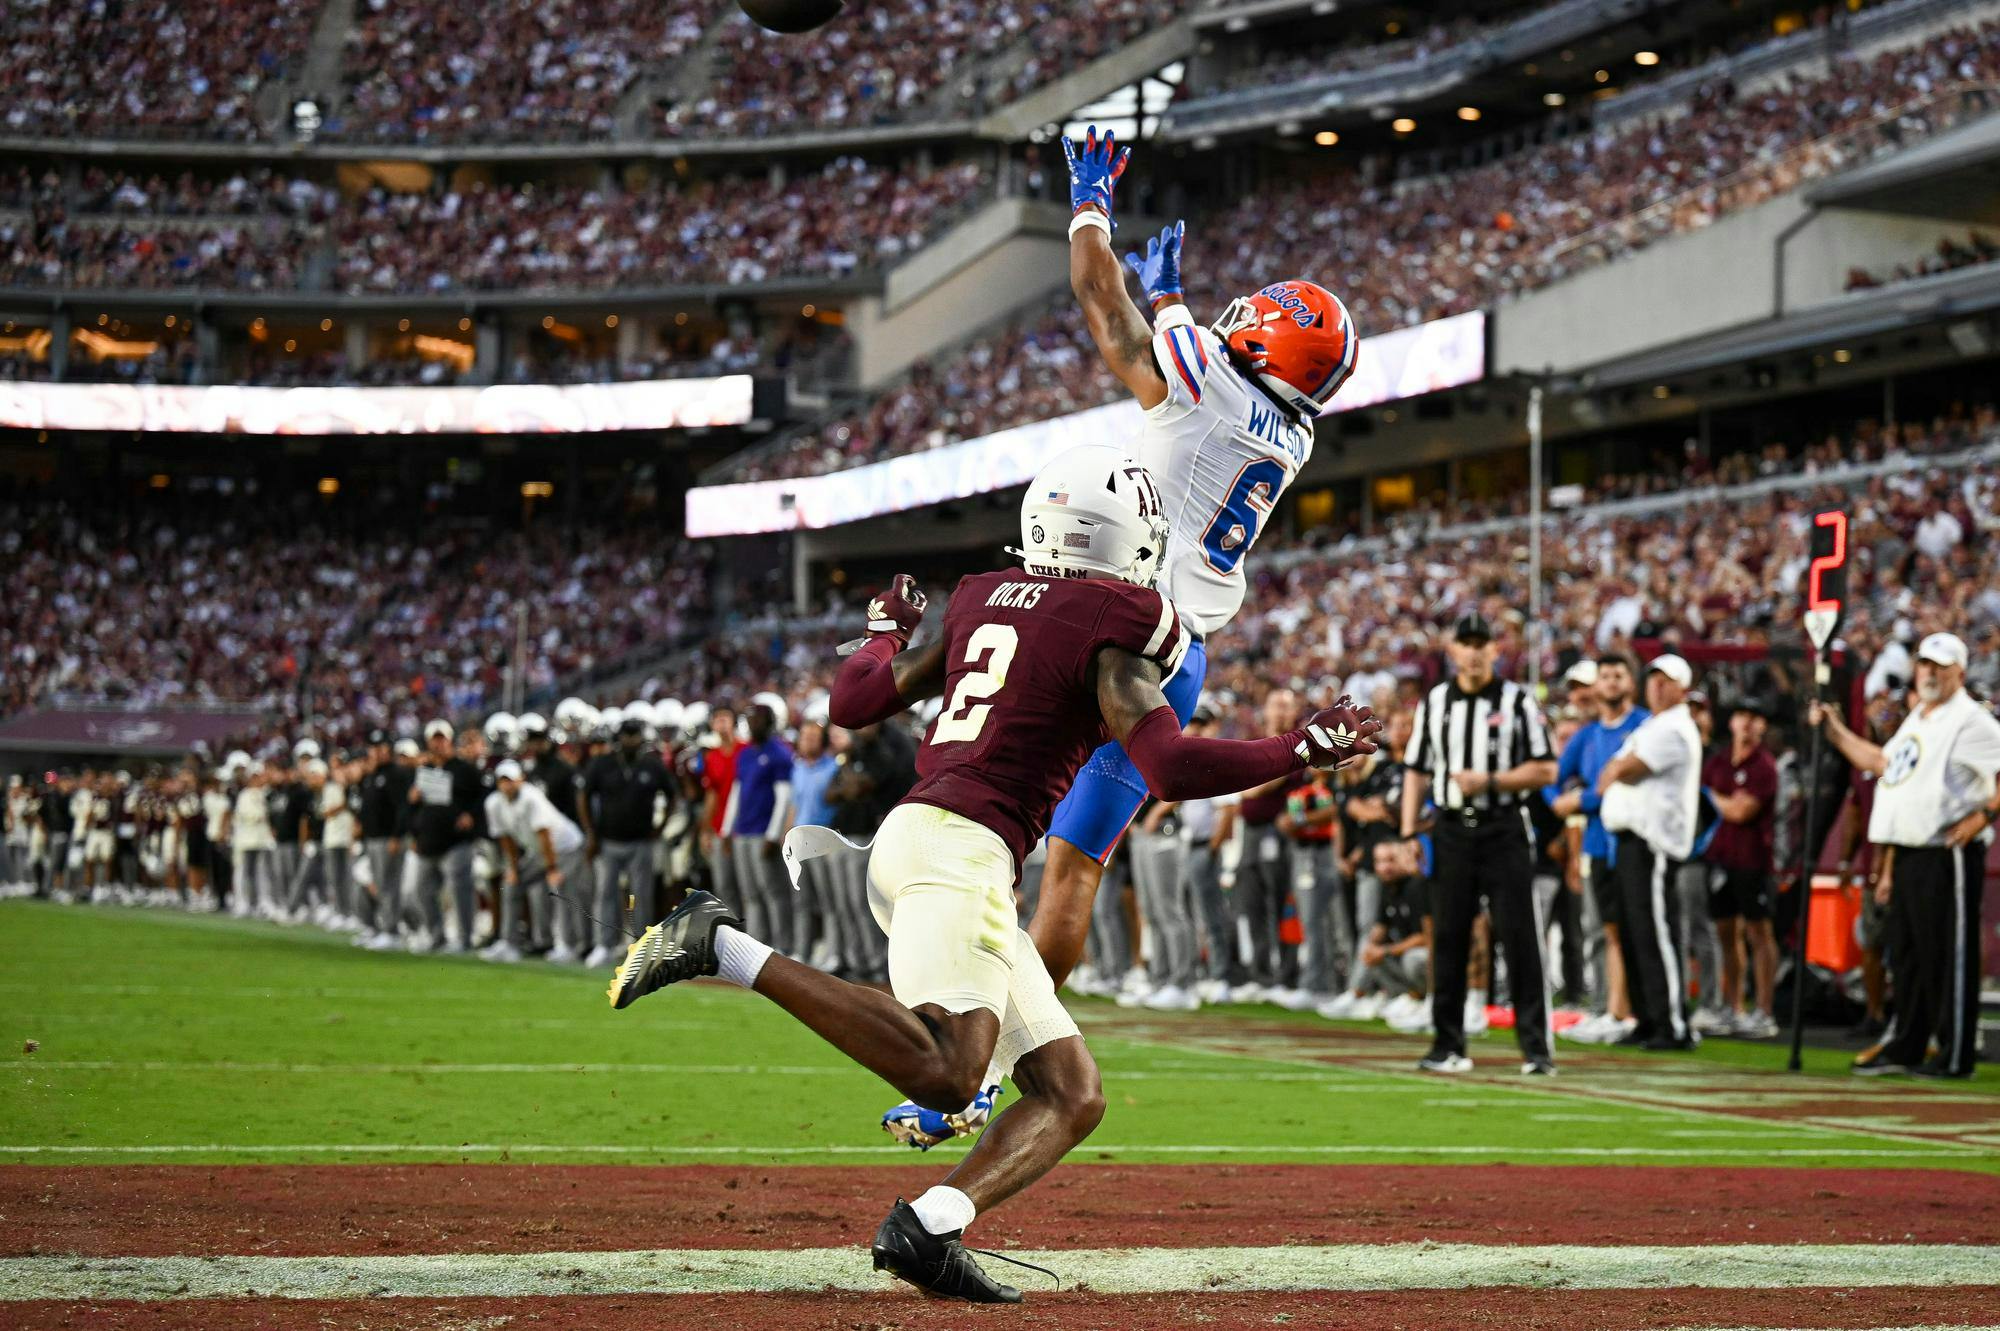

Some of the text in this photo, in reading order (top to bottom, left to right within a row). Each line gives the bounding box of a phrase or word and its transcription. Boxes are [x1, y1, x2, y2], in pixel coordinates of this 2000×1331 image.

[1200, 456, 1287, 577] 6
[1030, 564, 1061, 578] TEXAS
[1051, 548, 1059, 559] 2
[1810, 511, 1847, 613] 2
[985, 582, 1049, 610] RICKS
[930, 623, 1019, 746] 2
